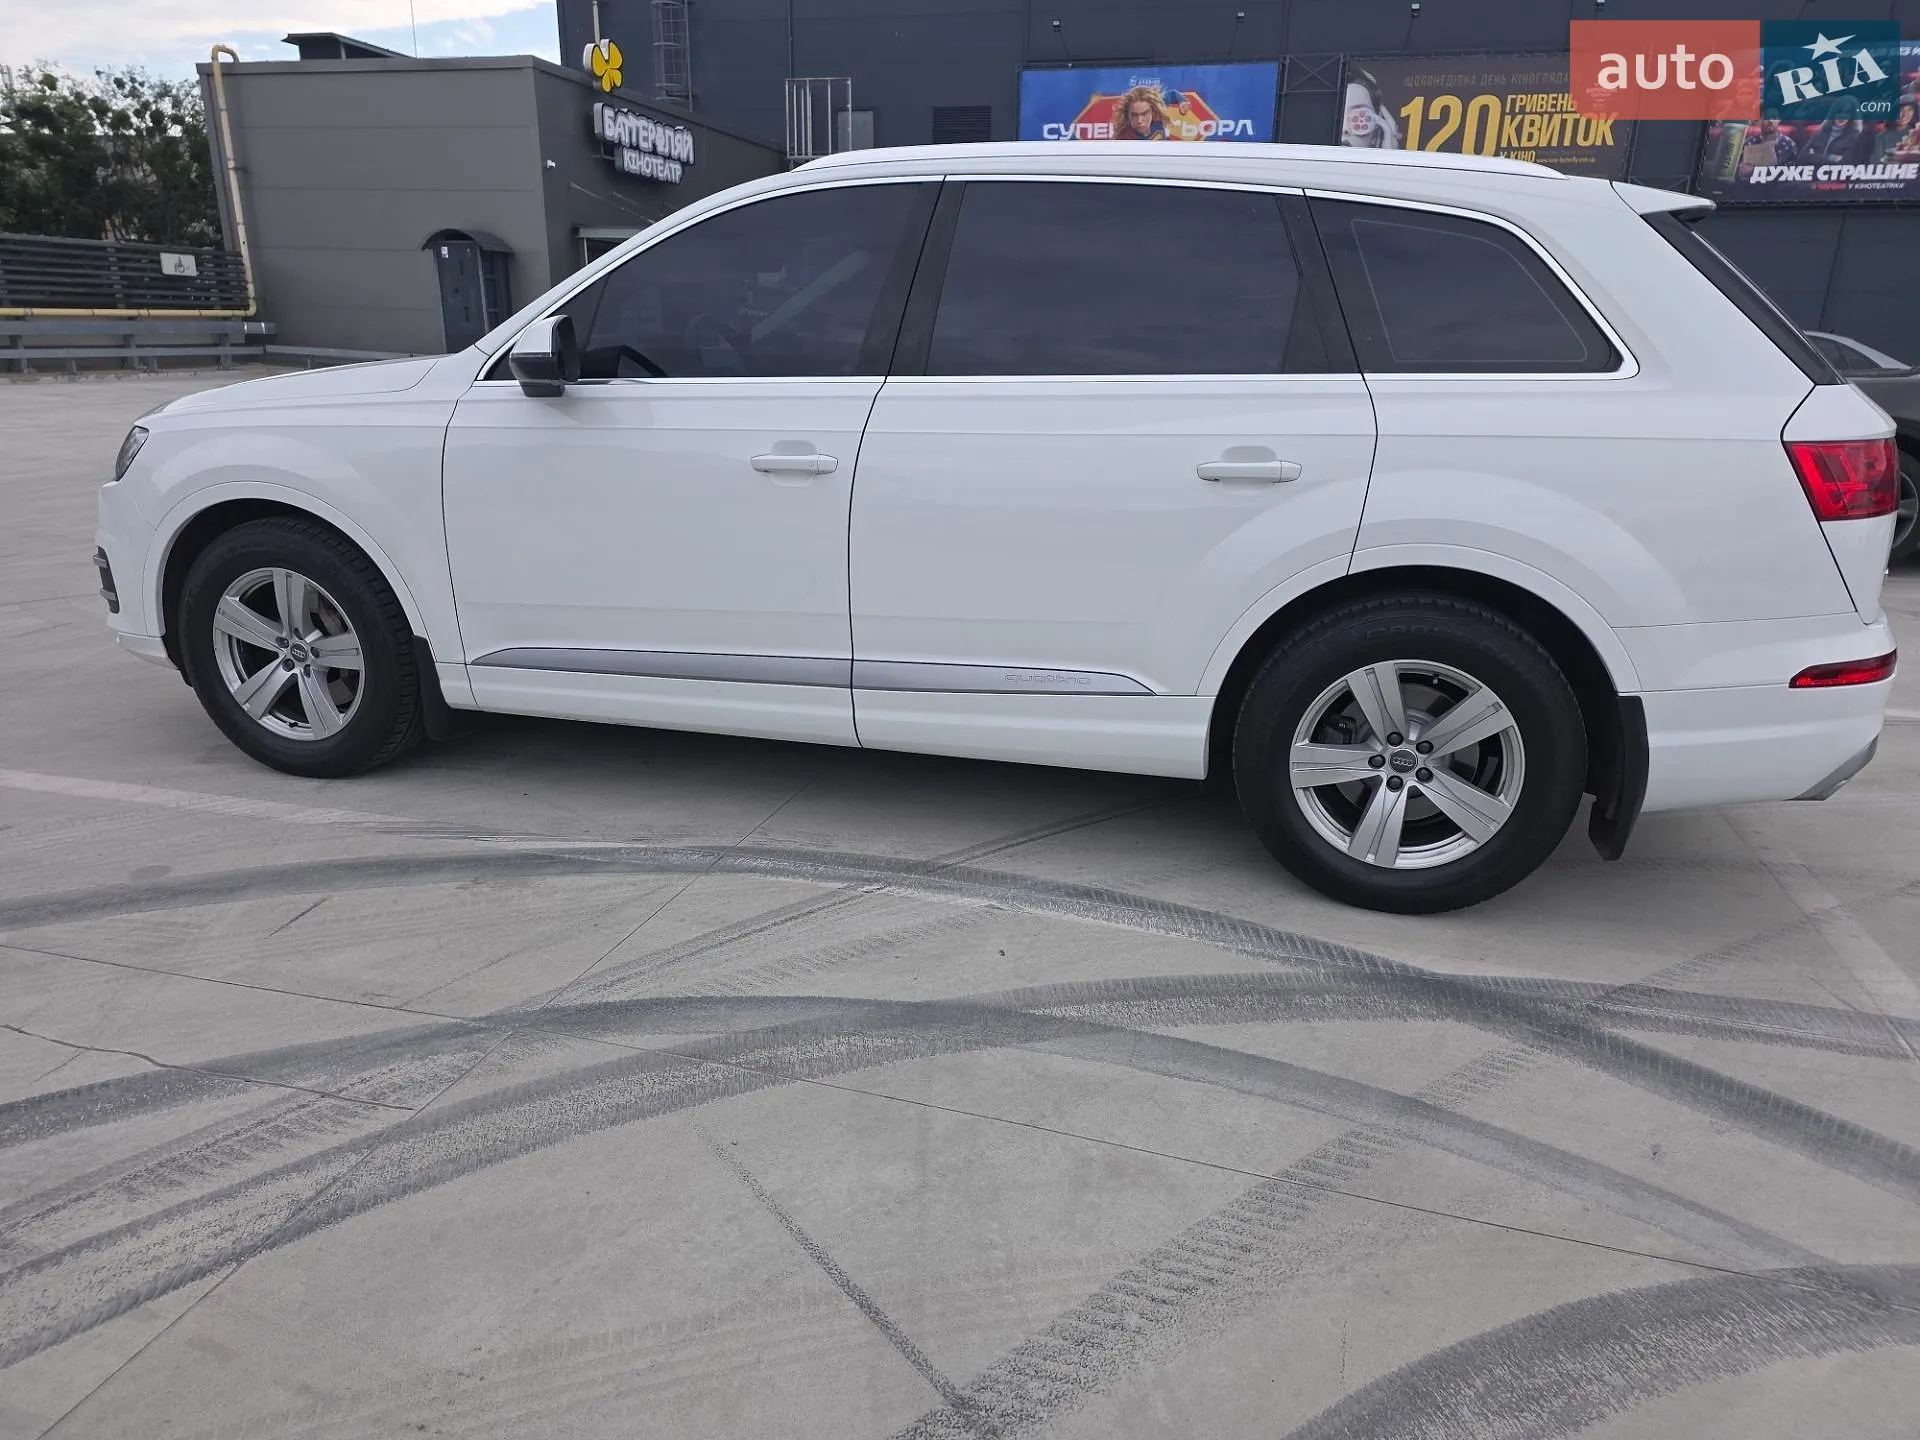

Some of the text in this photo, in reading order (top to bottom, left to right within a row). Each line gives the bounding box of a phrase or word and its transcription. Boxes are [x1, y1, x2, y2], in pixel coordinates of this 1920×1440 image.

[1480, 73, 1507, 86] ДЕНЬ
[1506, 93, 1578, 113] ГРИВЕНЬ
[1400, 95, 1501, 156] 120
[1501, 112, 1619, 148] КВИТОК
[623, 147, 683, 184] КІНОТЕАТР
[1510, 150, 1536, 162] КІНО
[1750, 163, 1920, 184] ДУЖЕ СТРАШНЕ
